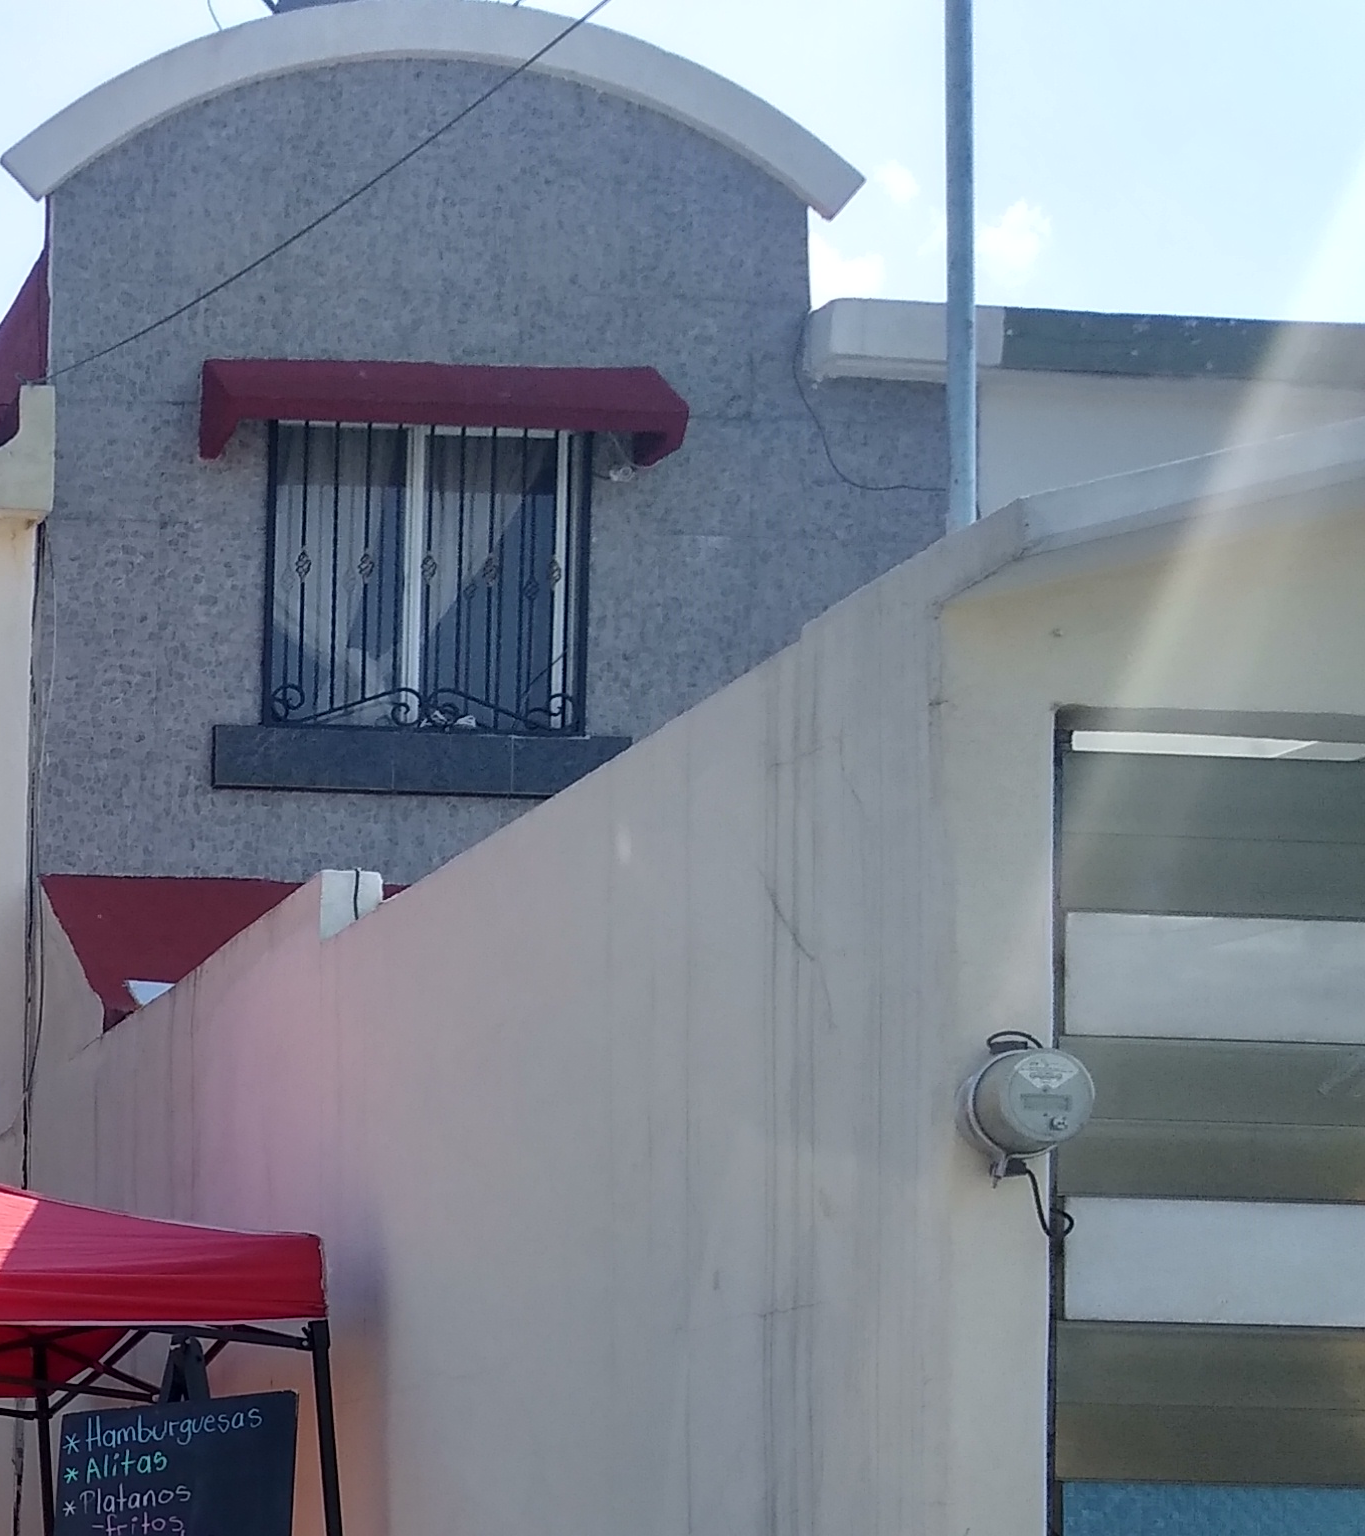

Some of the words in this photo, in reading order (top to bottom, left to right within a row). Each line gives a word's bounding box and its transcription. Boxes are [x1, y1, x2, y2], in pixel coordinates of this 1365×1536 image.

[85, 1407, 263, 1451] Hamburguesas
[86, 1449, 168, 1484] Alitas
[79, 1482, 192, 1516] Platanos
